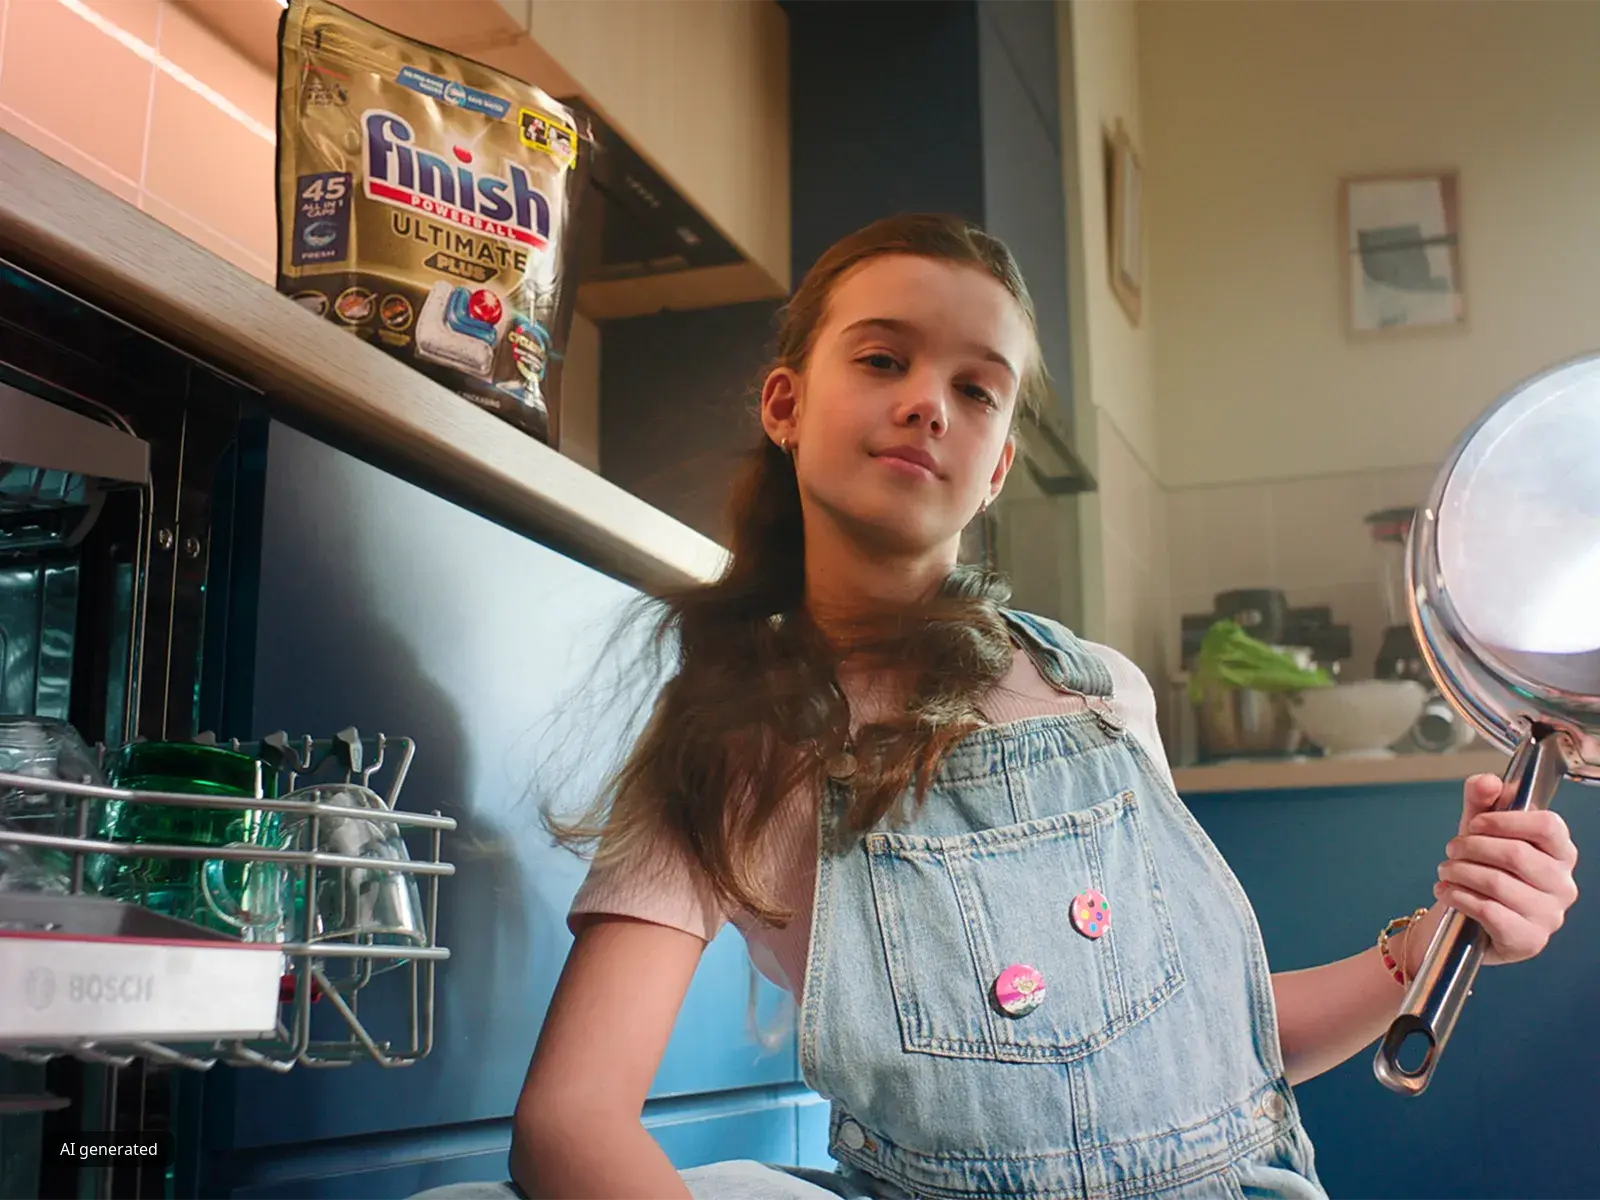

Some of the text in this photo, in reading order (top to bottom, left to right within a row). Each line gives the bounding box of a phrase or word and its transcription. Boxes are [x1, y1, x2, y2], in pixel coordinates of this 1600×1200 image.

[302, 176, 346, 201] 45
[366, 114, 550, 239] finish
[410, 195, 517, 240] POWERBALL
[393, 212, 529, 274] ULTIMATE
[436, 252, 488, 281] PLUS
